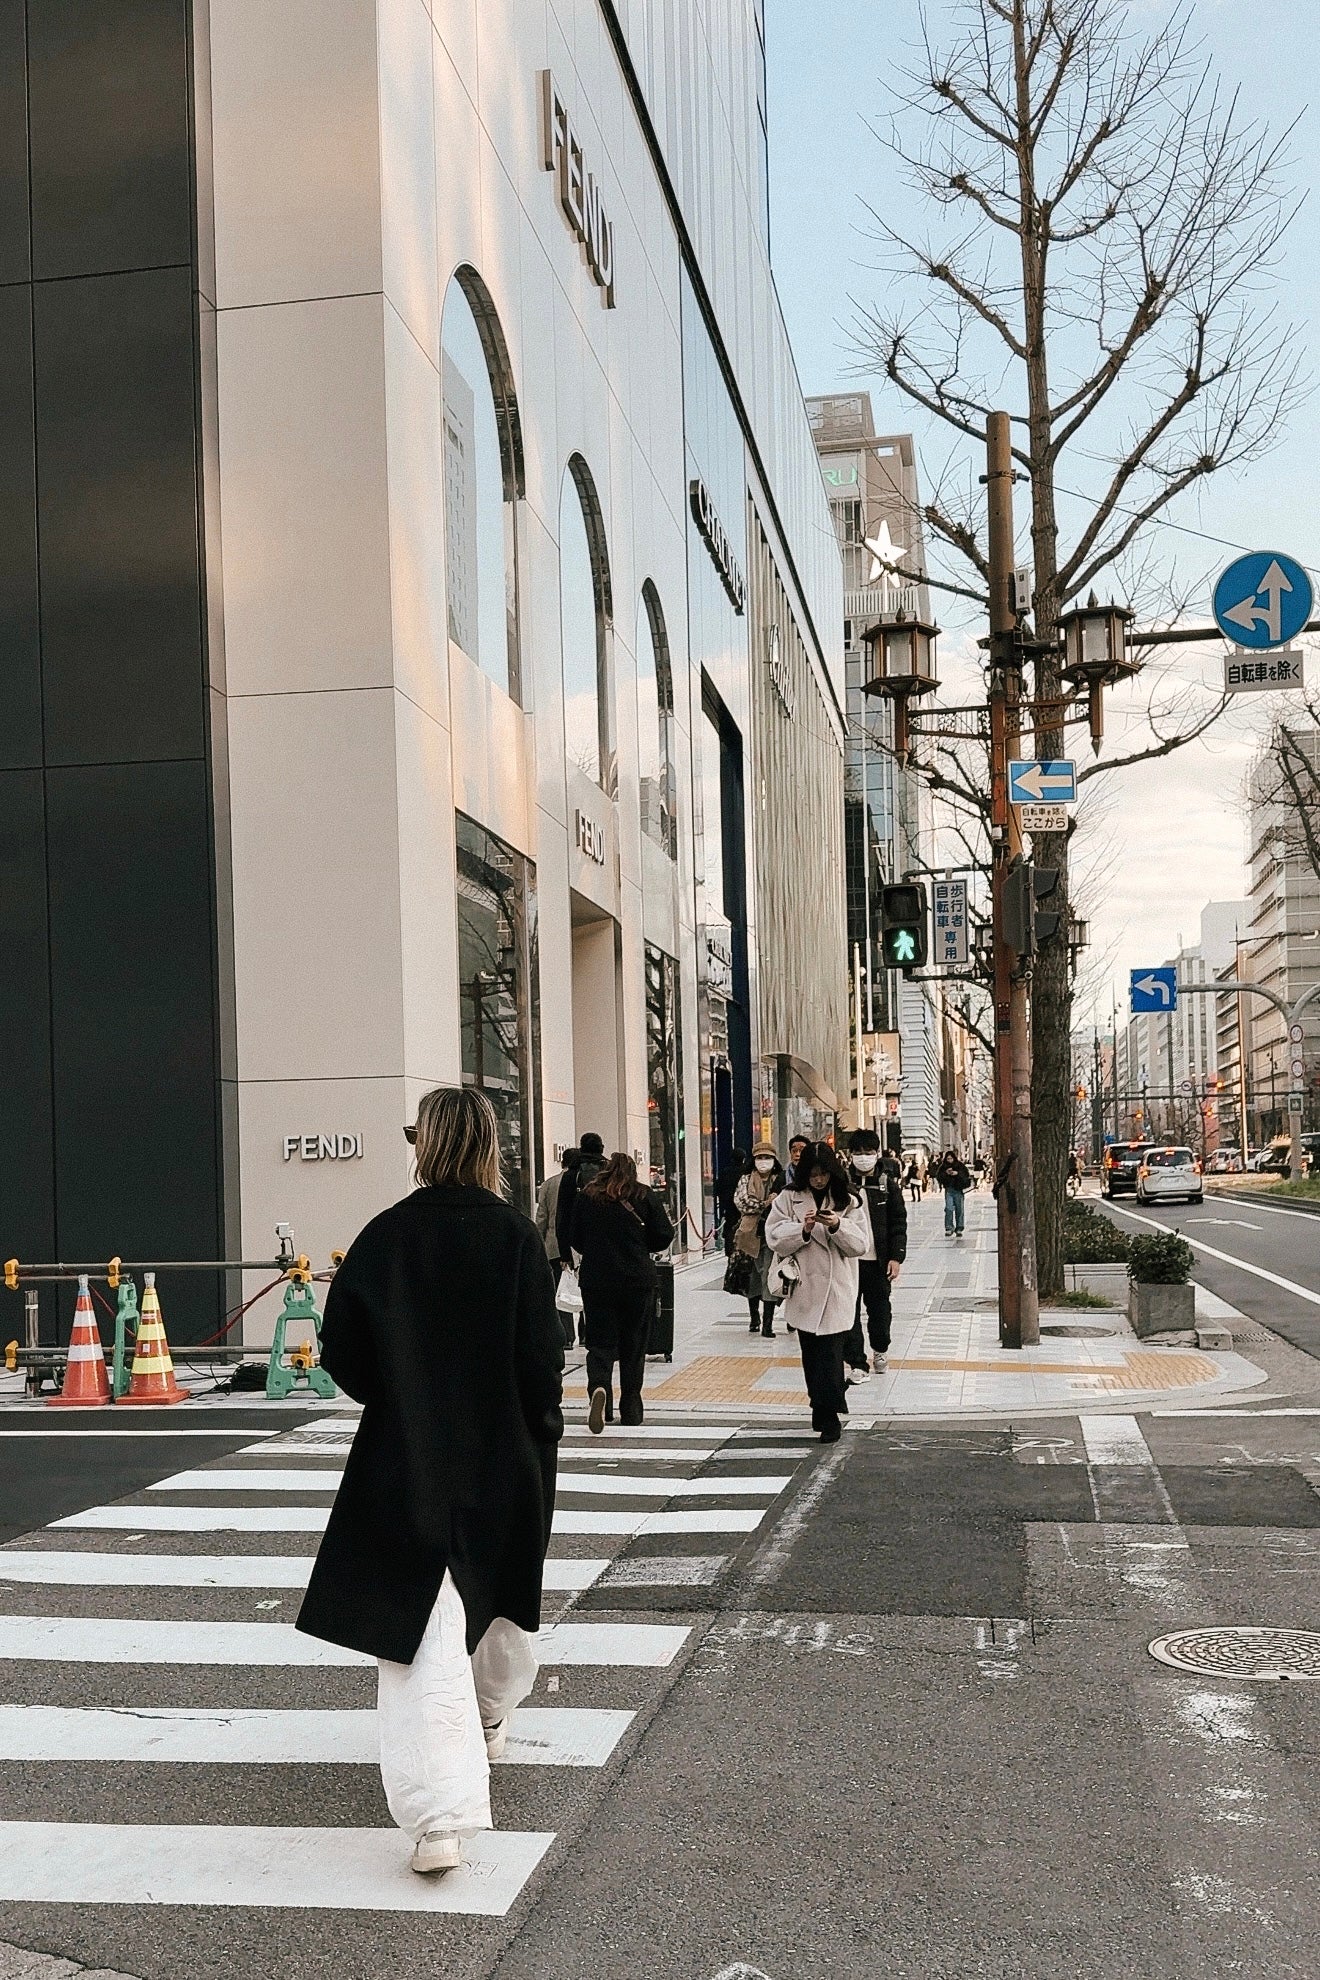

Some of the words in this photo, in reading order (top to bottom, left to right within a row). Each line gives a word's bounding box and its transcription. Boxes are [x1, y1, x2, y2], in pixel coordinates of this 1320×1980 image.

[536, 69, 617, 309] FENDI
[1228, 660, 1300, 684] 自転車を除く
[1023, 817, 1066, 828] ここから
[283, 1132, 364, 1161] FENDI
